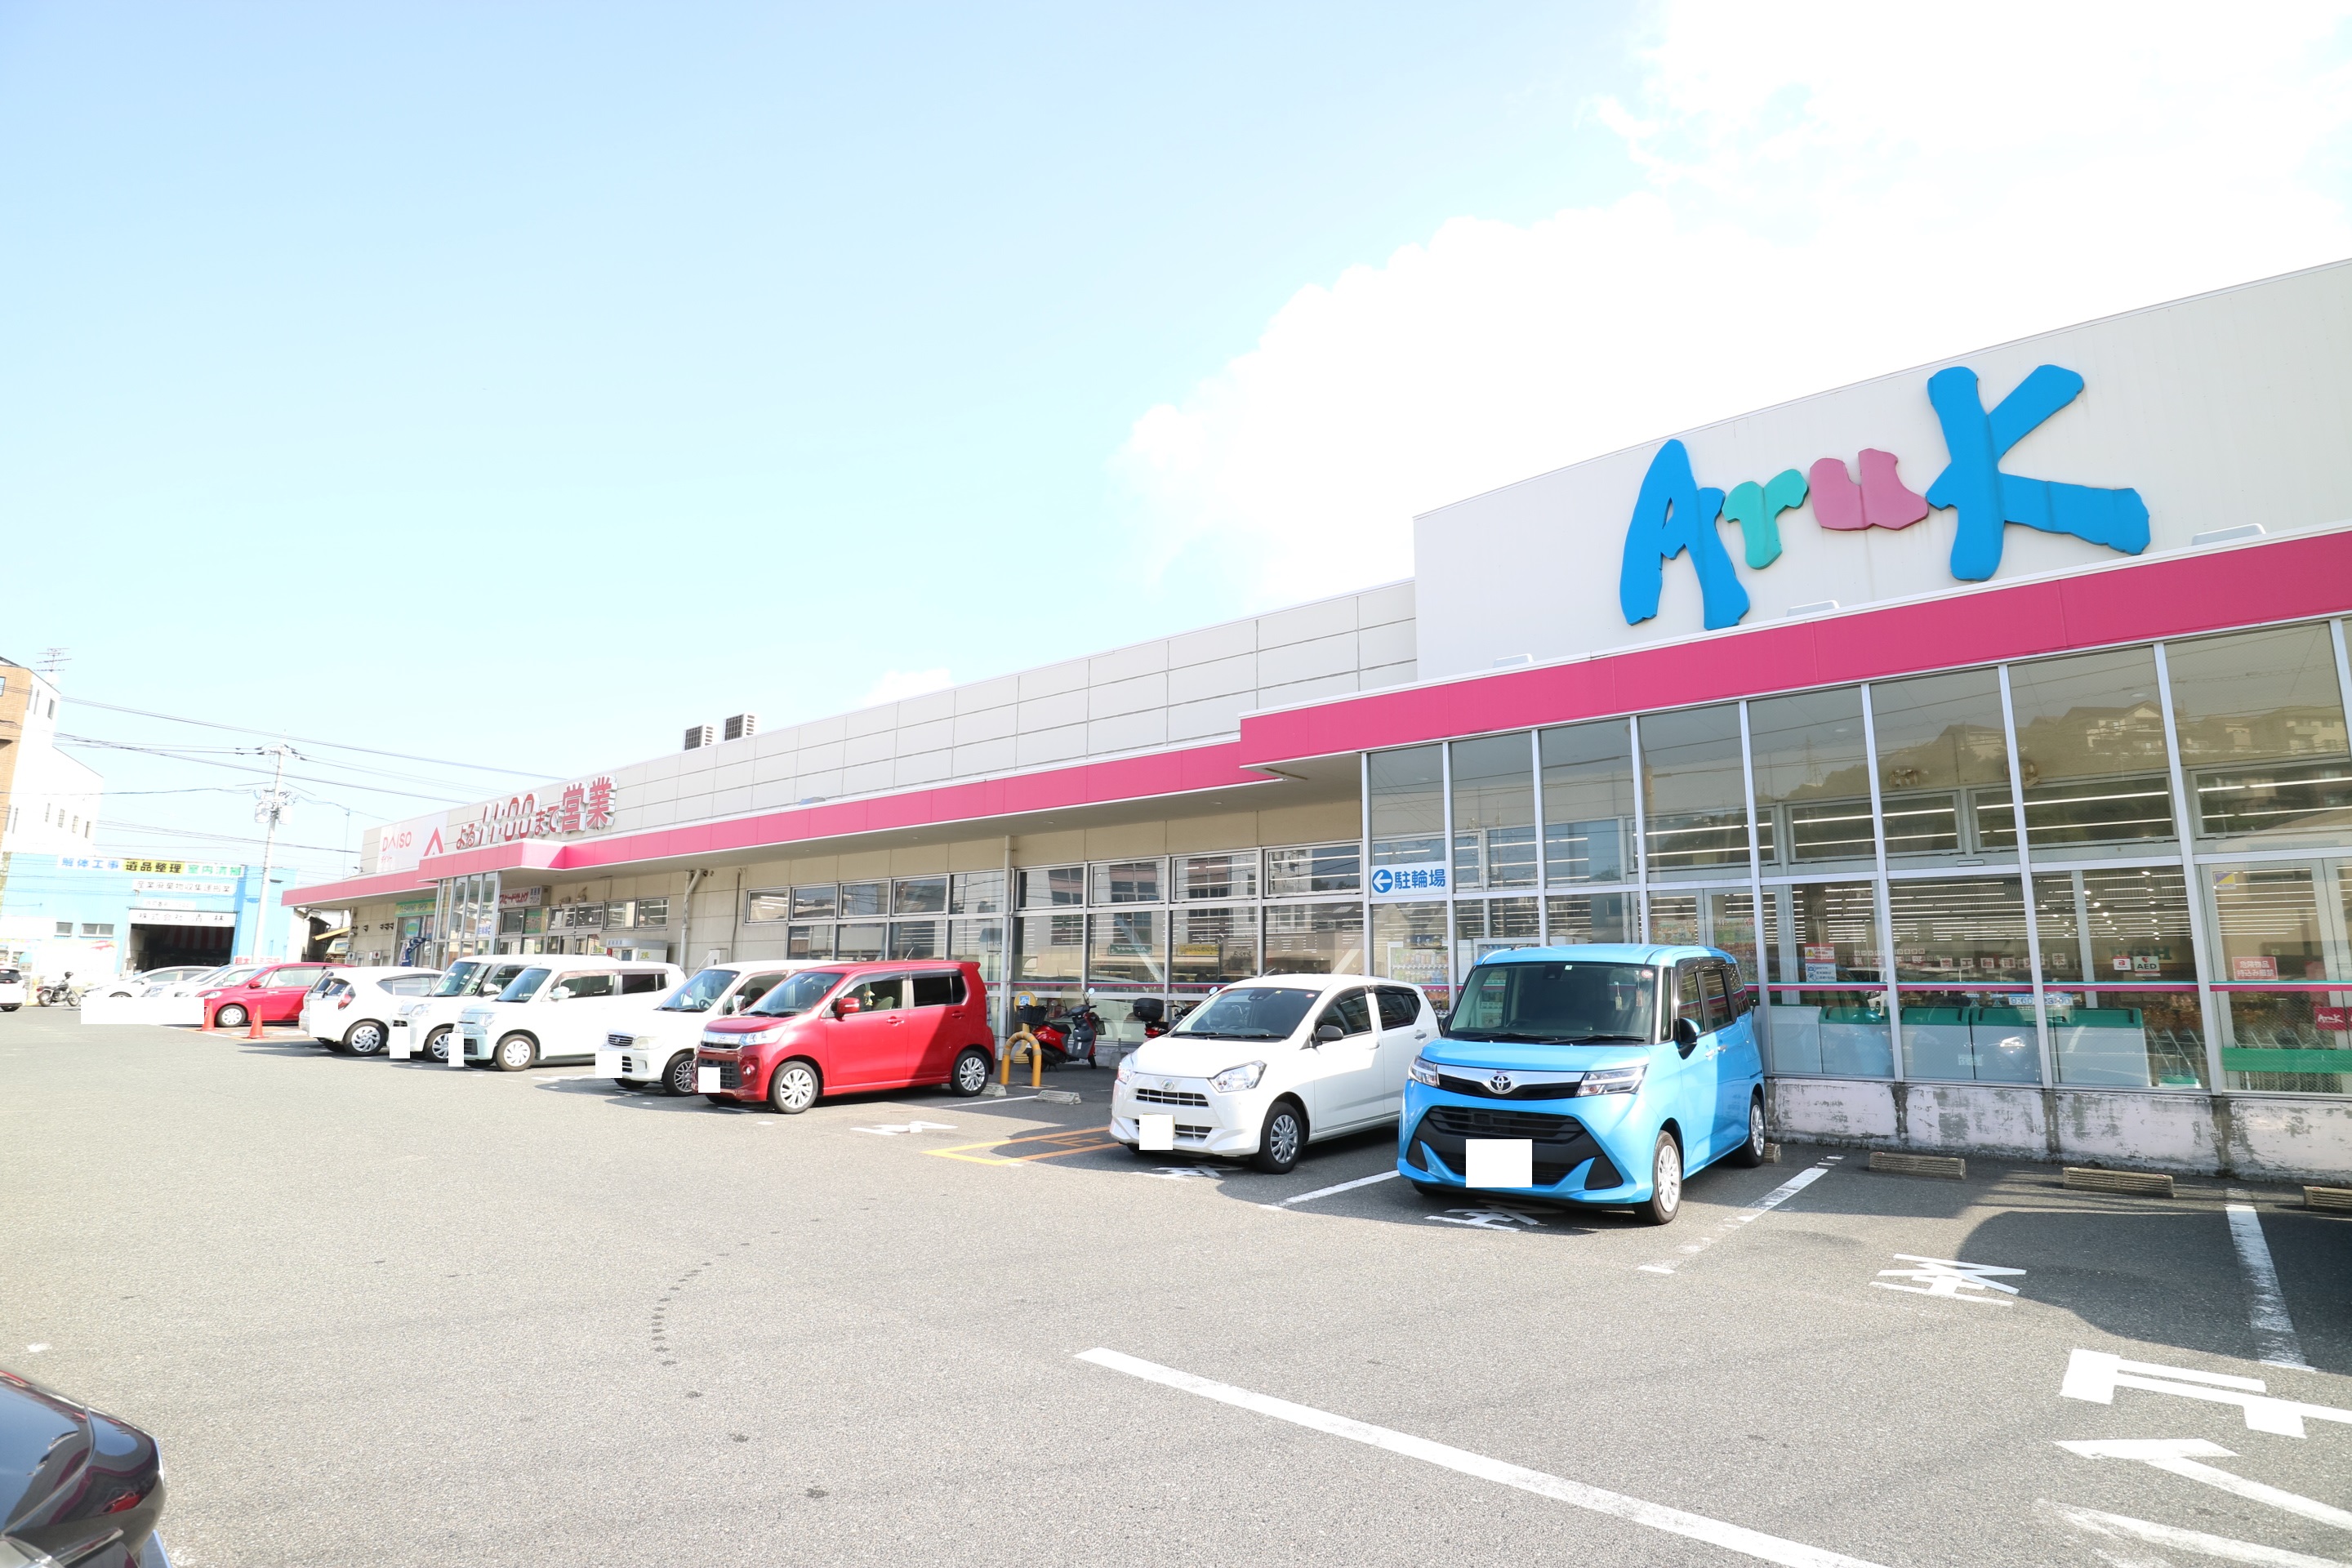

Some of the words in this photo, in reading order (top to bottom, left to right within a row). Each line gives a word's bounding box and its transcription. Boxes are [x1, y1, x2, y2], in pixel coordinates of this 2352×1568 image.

[382, 831, 412, 852] DAISO
[61, 858, 119, 870] 解体工事
[126, 861, 182, 874] 遺品整理
[1394, 868, 1446, 890] 駐輪場
